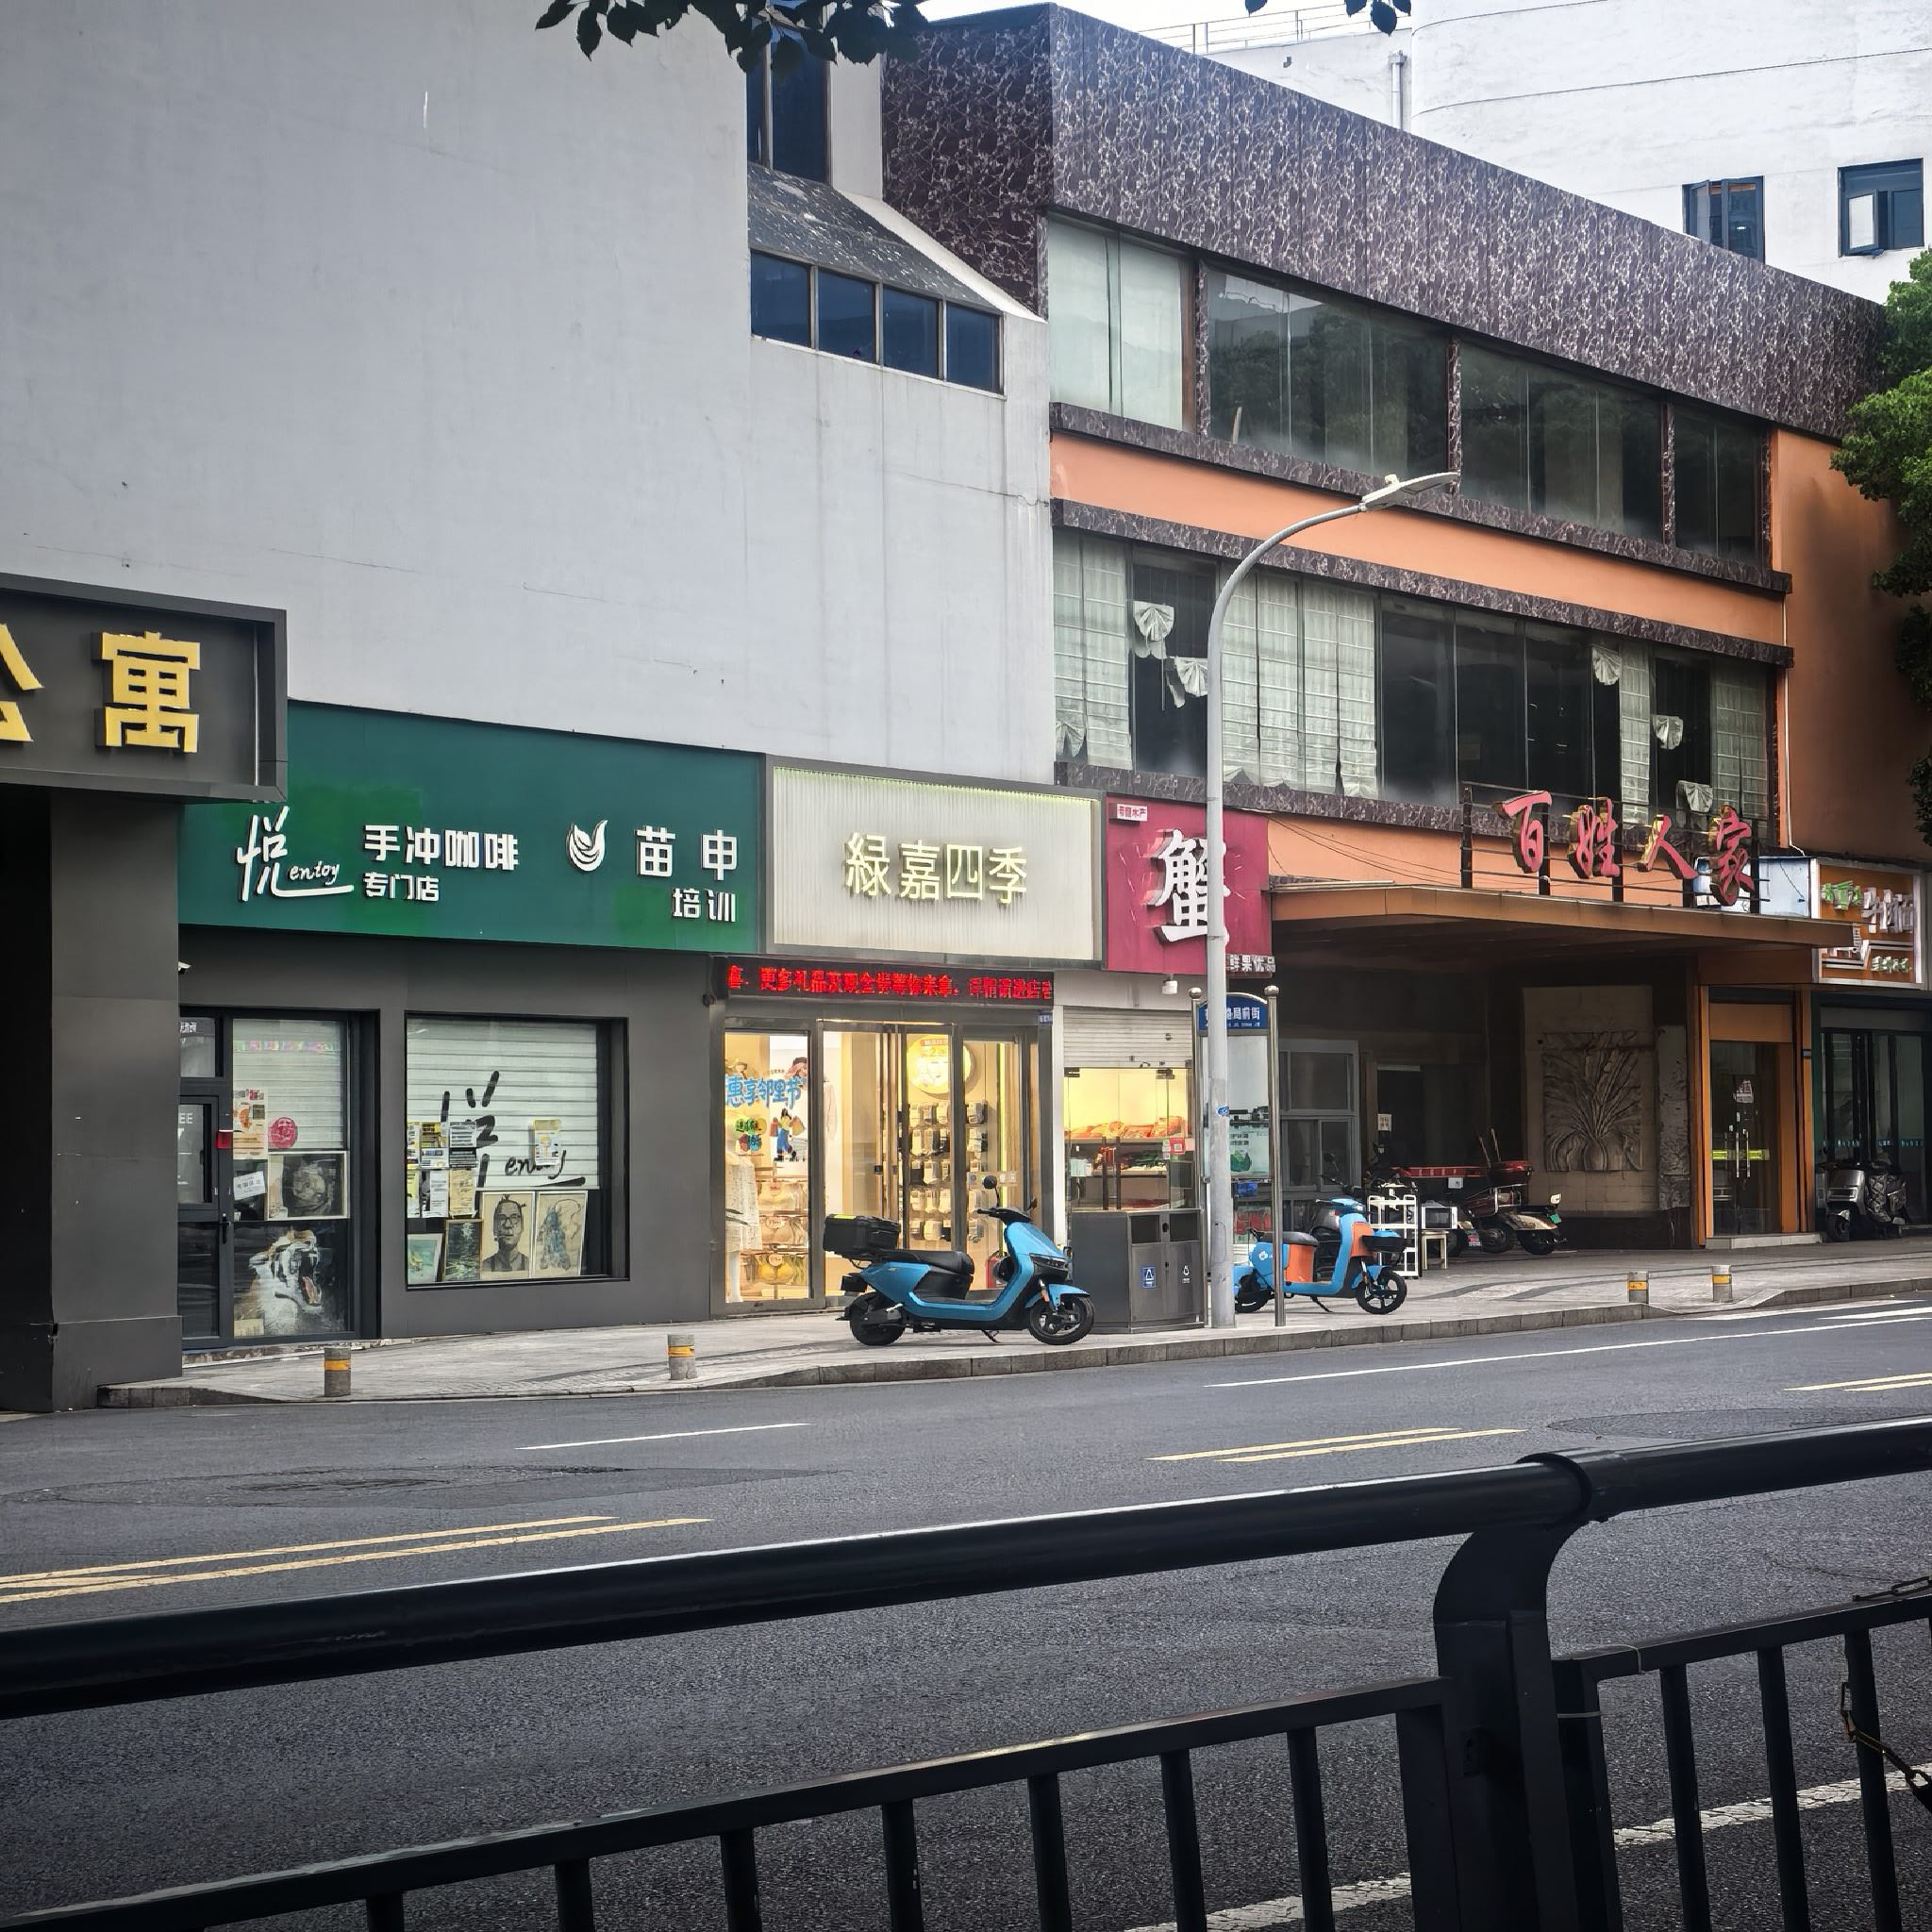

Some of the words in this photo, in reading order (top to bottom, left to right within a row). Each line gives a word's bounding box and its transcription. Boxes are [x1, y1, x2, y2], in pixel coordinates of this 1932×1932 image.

[363, 824, 520, 871] 手冲咖啡
[636, 824, 739, 881] 苗申
[1498, 790, 1755, 907] 百姓人家
[363, 872, 440, 902] 专门店
[672, 887, 737, 923] 培训
[725, 1074, 803, 1110] 惠享邻里节
